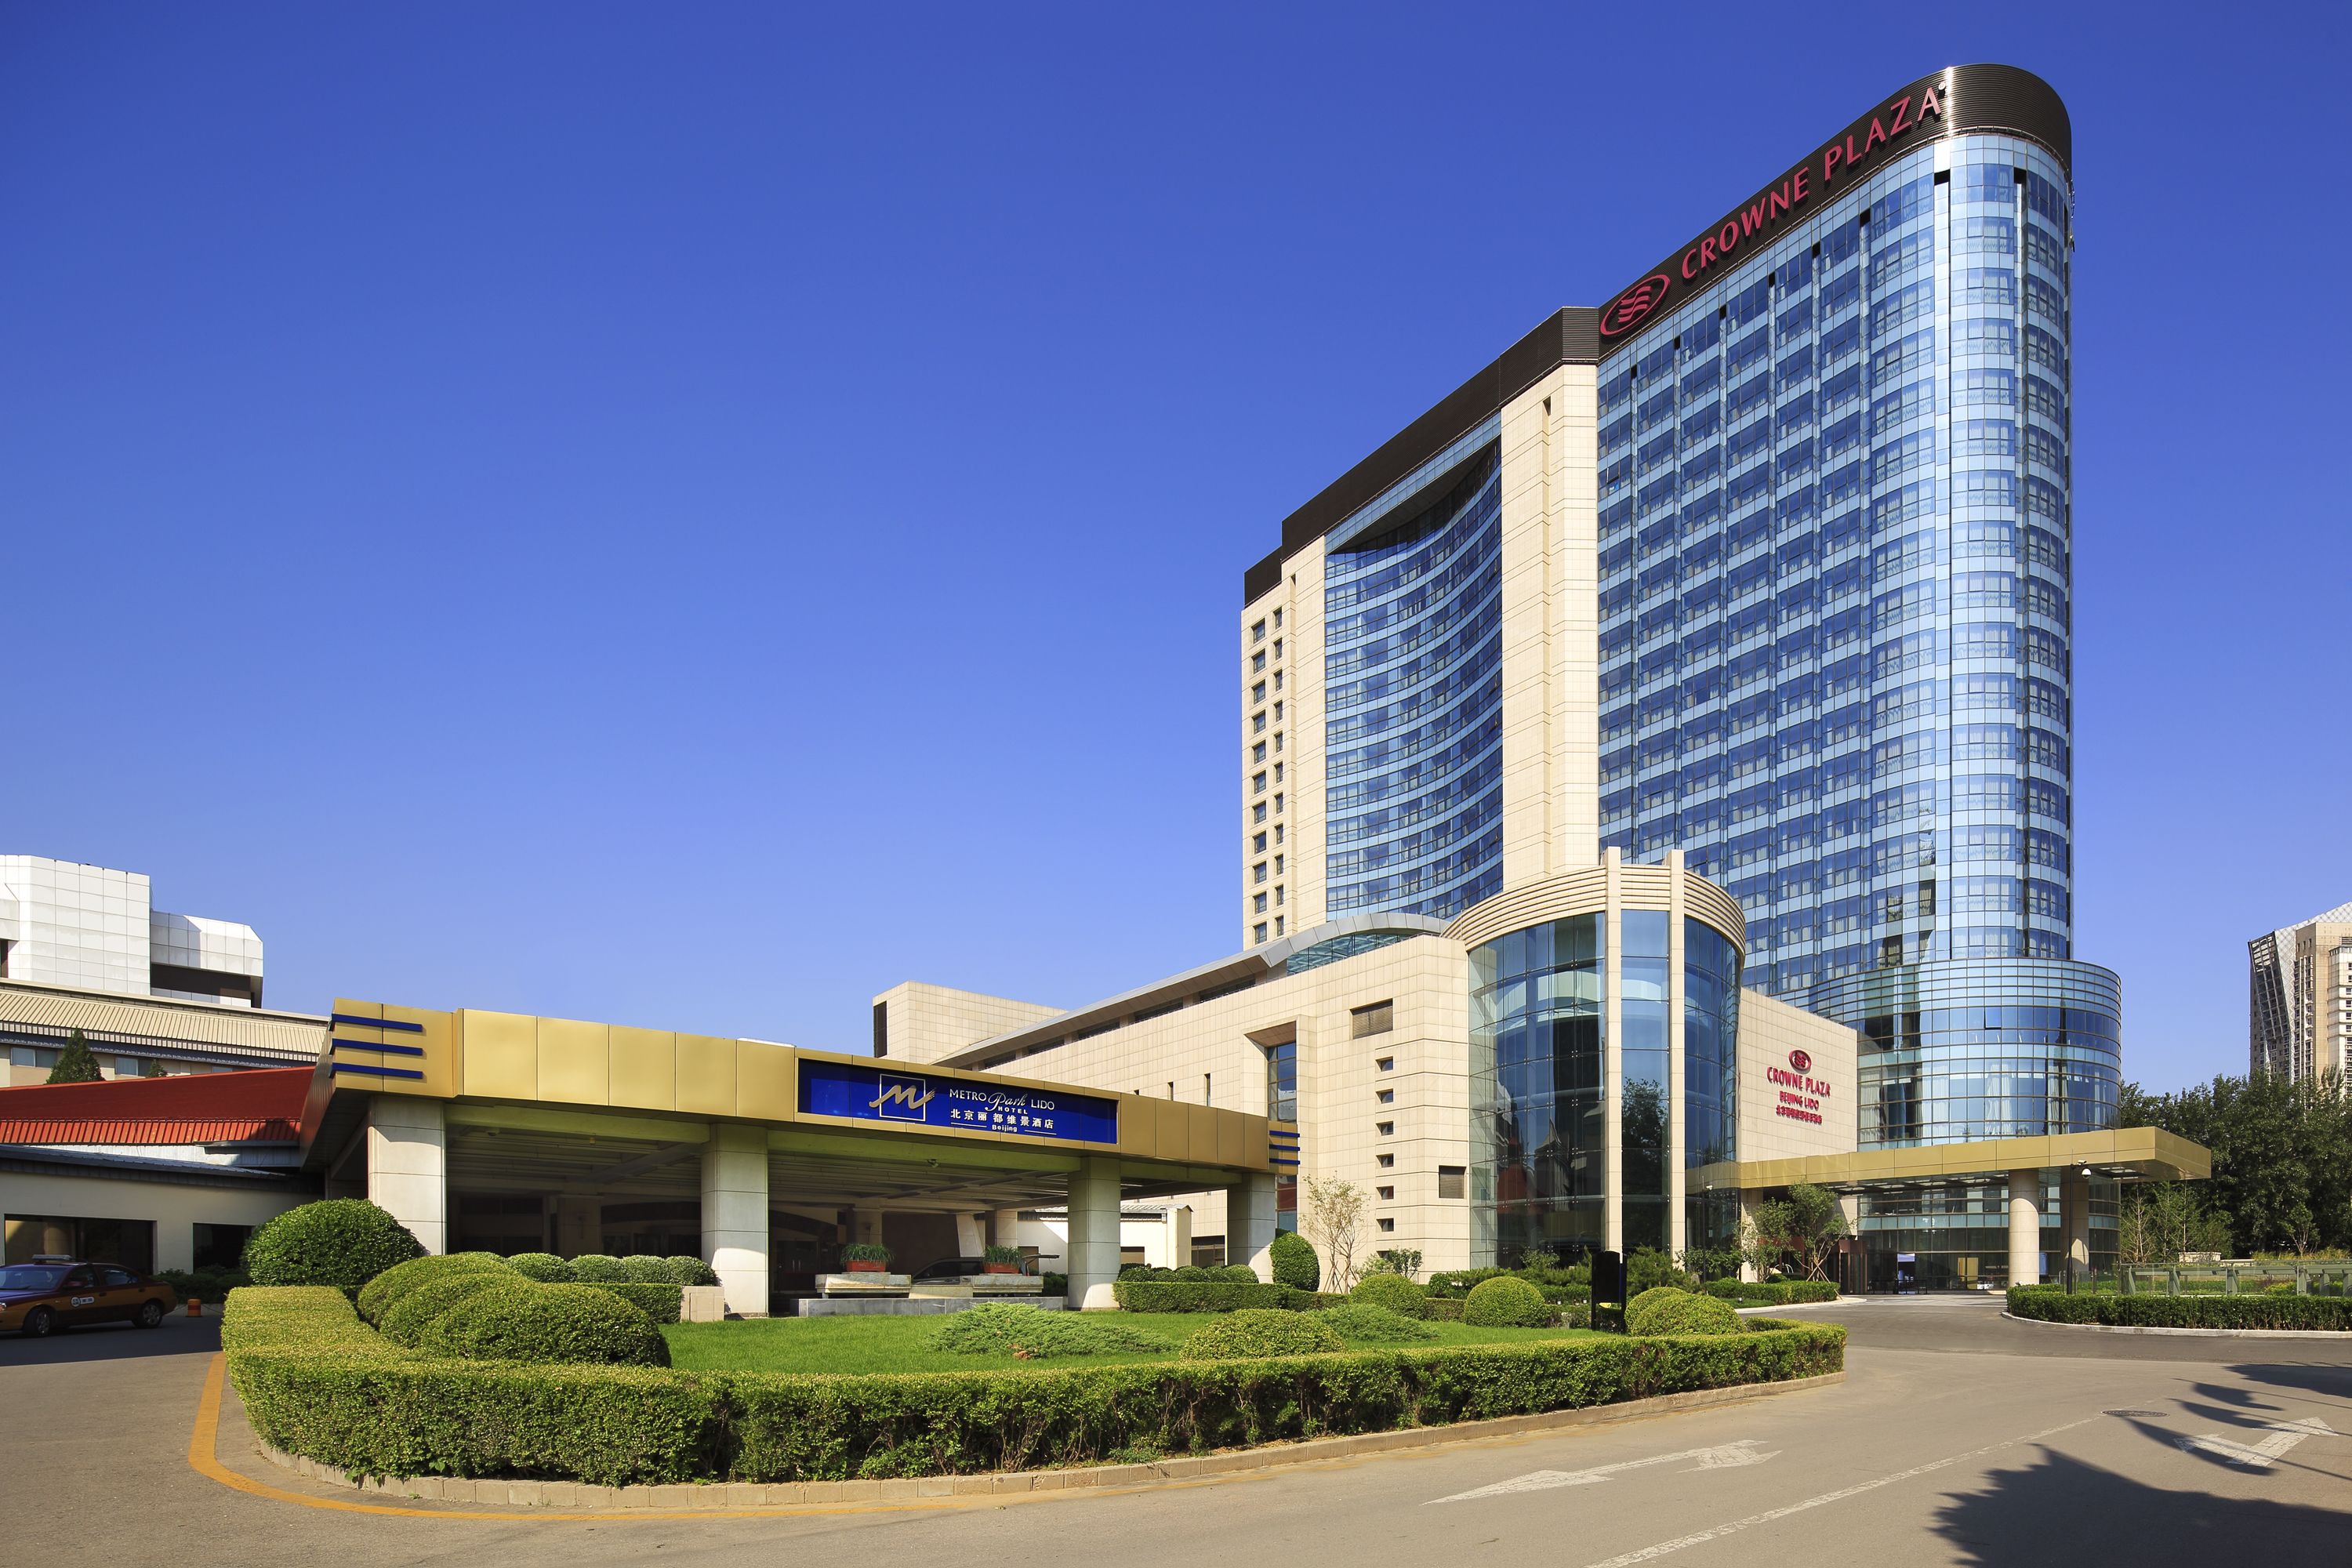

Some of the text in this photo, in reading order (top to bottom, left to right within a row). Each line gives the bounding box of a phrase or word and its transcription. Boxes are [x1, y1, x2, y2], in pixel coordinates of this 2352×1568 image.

[1681, 87, 1942, 279] CROWNE PLAZA
[1766, 1066, 1831, 1099] CROWNE PLAZA
[997, 1106, 1028, 1115] HOTEL
[1030, 1099, 1054, 1110] LIDO
[1804, 1097, 1820, 1111] LIDO
[950, 1109, 1054, 1129] 北京丽都维景酒店
